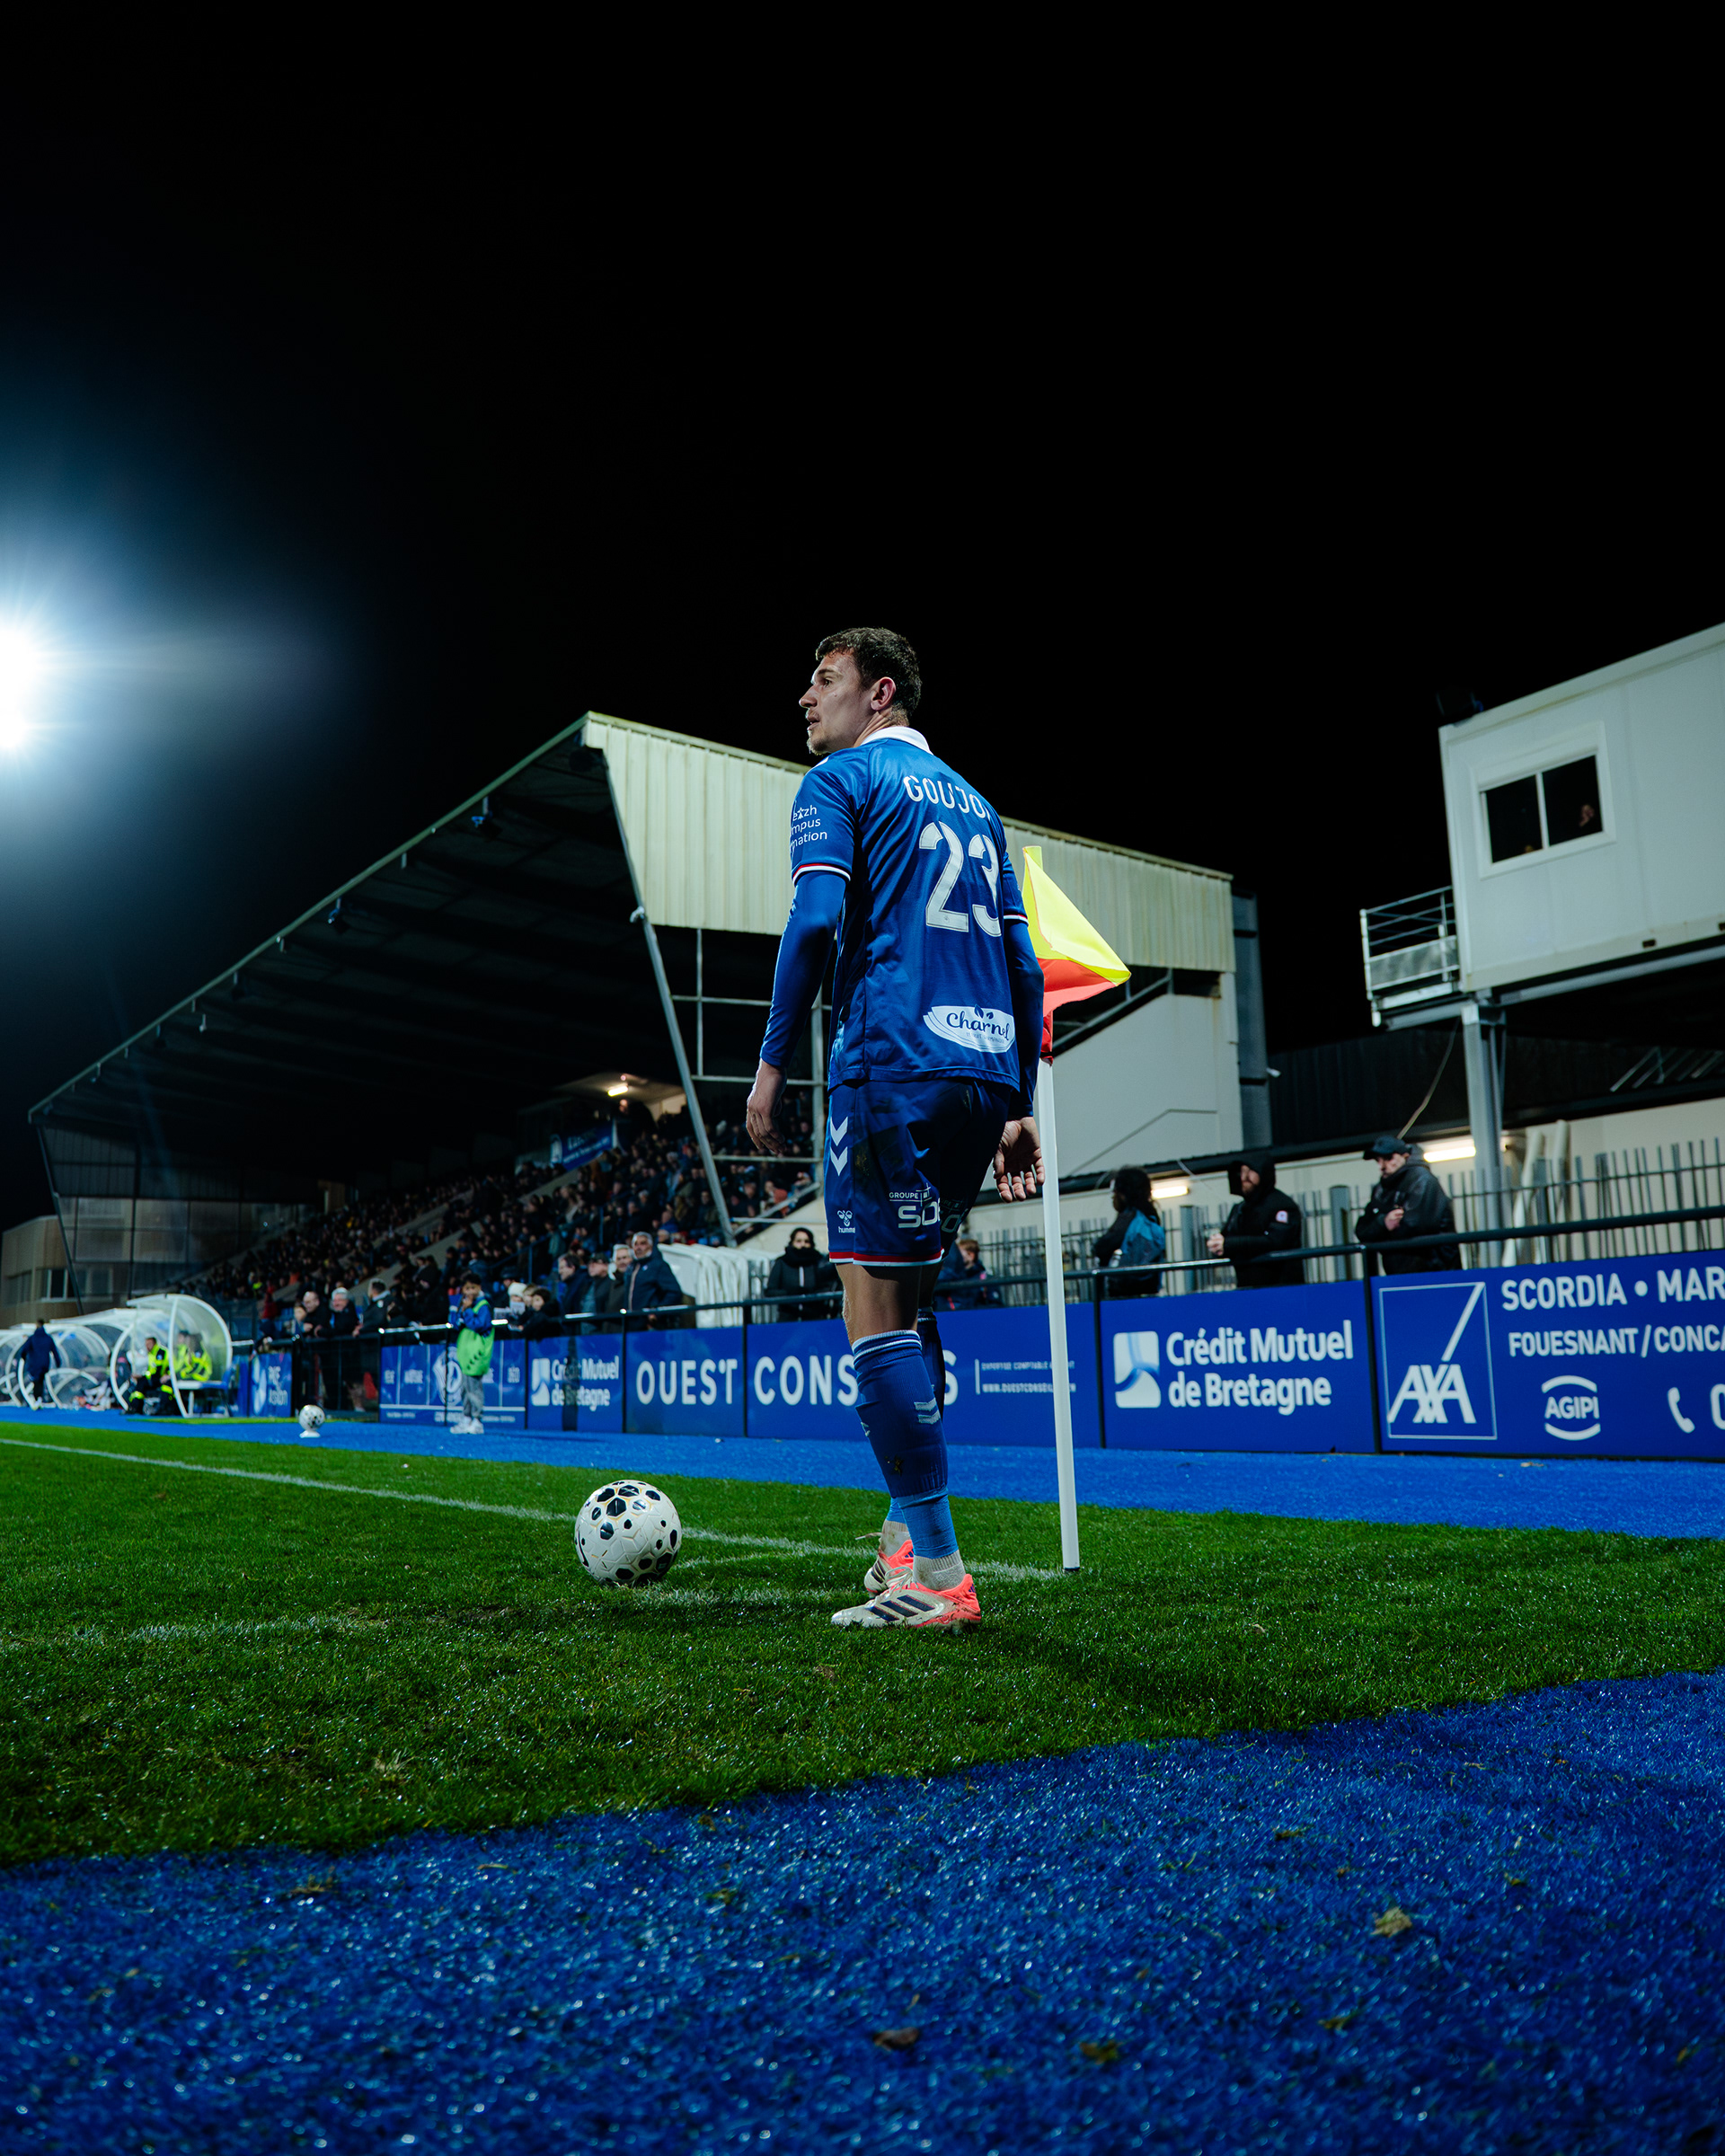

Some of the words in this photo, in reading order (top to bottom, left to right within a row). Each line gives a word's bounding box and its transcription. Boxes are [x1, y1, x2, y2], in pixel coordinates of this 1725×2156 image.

[790, 831, 827, 850] mation
[791, 818, 821, 836] mpus
[919, 821, 1002, 936] 23
[889, 1191, 919, 1199] GROUPE
[898, 1197, 941, 1229] SO
[1501, 1273, 1627, 1312] SCORDIA
[1657, 1266, 1725, 1303] MAR
[1166, 1327, 1247, 1366] Crédit
[1251, 1320, 1354, 1362] Mutuel
[581, 1355, 620, 1380] Mutuel
[635, 1358, 739, 1406] OUEST
[754, 1349, 959, 1407] CONSS
[551, 1383, 565, 1406] de
[1168, 1371, 1202, 1408] de
[1205, 1374, 1332, 1415] Bretagne
[1387, 1362, 1478, 1425] AXA
[1544, 1396, 1600, 1419] AGIPI
